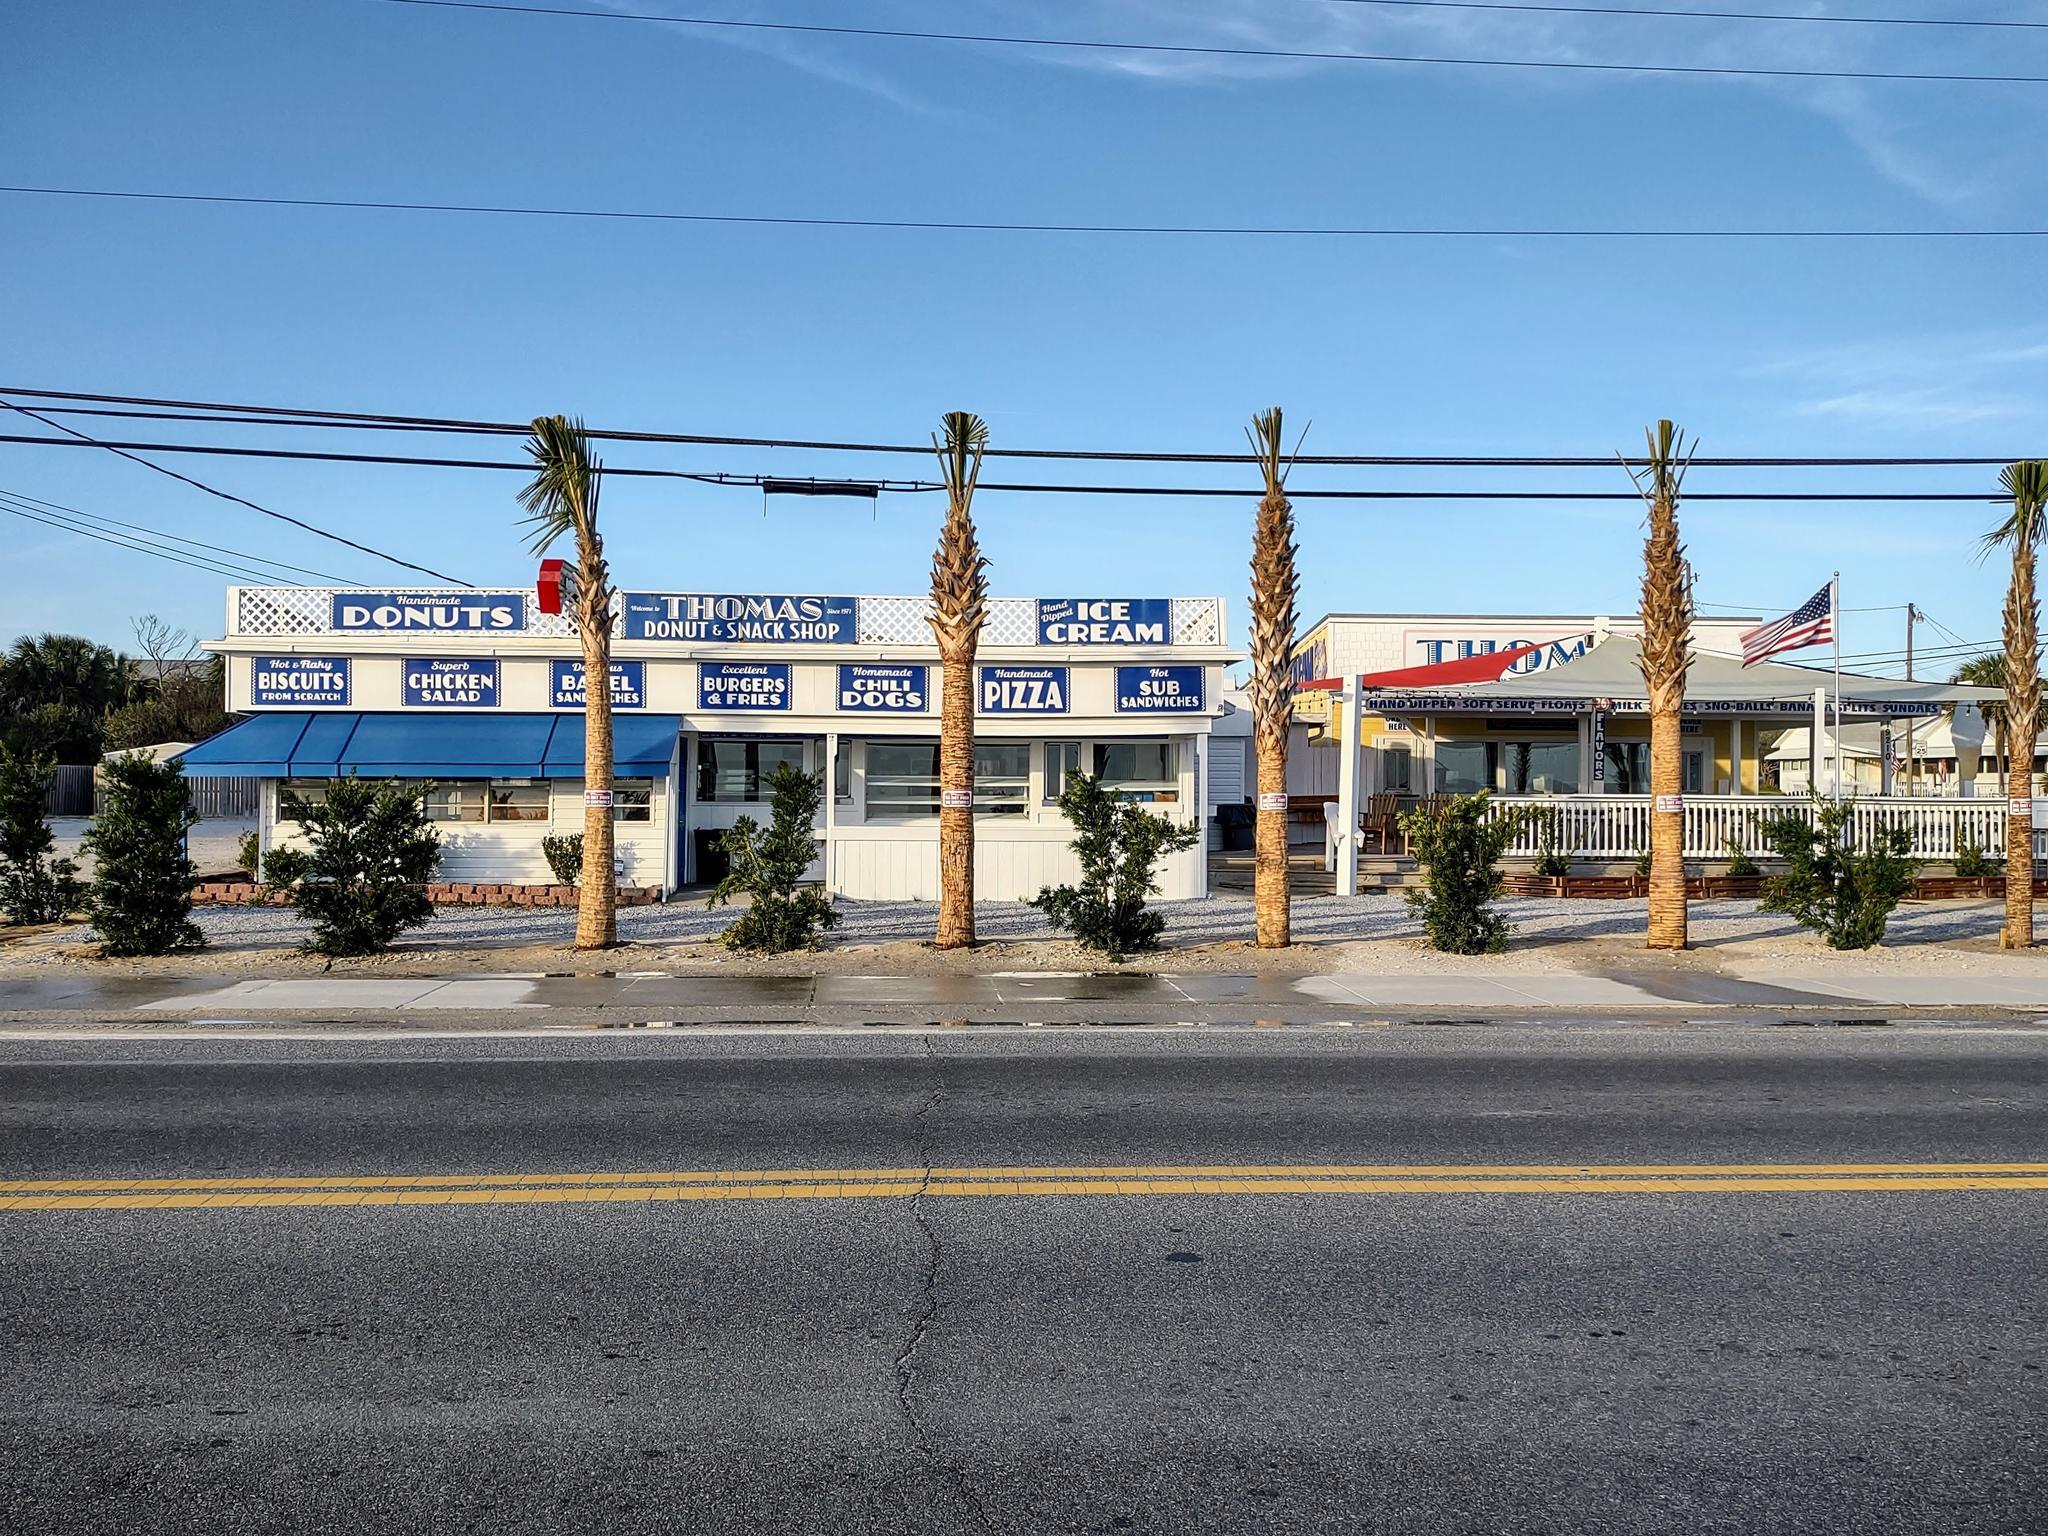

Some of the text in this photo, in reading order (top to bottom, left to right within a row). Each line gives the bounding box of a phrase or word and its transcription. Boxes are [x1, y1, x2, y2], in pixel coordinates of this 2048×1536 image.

[397, 596, 461, 605] Handmade
[1042, 600, 1069, 614] Hand
[660, 597, 828, 621] THOMAS'
[1041, 608, 1073, 622] Dipped
[1078, 602, 1130, 621] ICE
[343, 606, 514, 627] DONUTS
[644, 621, 840, 640] DONUT & SNACK SHOP
[1046, 623, 1163, 642] CREAM
[269, 660, 290, 669] Hot
[300, 660, 333, 671] Flaky
[431, 661, 470, 672] Superb
[721, 665, 768, 674] Excellent
[852, 667, 913, 677] Homemade
[994, 669, 1053, 678] Handmade
[1150, 668, 1169, 677] Hot
[258, 672, 344, 690] BISCUITS
[408, 673, 494, 689] CHICKEN
[561, 675, 635, 691] BAEL
[704, 677, 785, 693] BURGERS
[853, 679, 910, 691] CHILI
[984, 681, 1064, 708] PIZZA
[1139, 680, 1180, 696] SUB
[294, 693, 341, 701] SCRATCH
[421, 690, 481, 702] SALAD
[707, 693, 781, 706] & FRIES
[842, 691, 923, 707] DOGS
[1121, 696, 1199, 708] SANDWICHES
[1369, 700, 1405, 708] HAND
[1462, 700, 1493, 709] SOFT
[1496, 700, 1535, 709] SERVE
[1541, 701, 1585, 709] FLOATS
[1611, 701, 1643, 709] MILK
[1704, 702, 1773, 711] SNO-BALLS
[1779, 702, 1833, 712] BANAA
[1882, 703, 1938, 713] SUNDAES
[1389, 722, 1407, 731] HERE
[1594, 712, 1604, 779] FLAVORS
